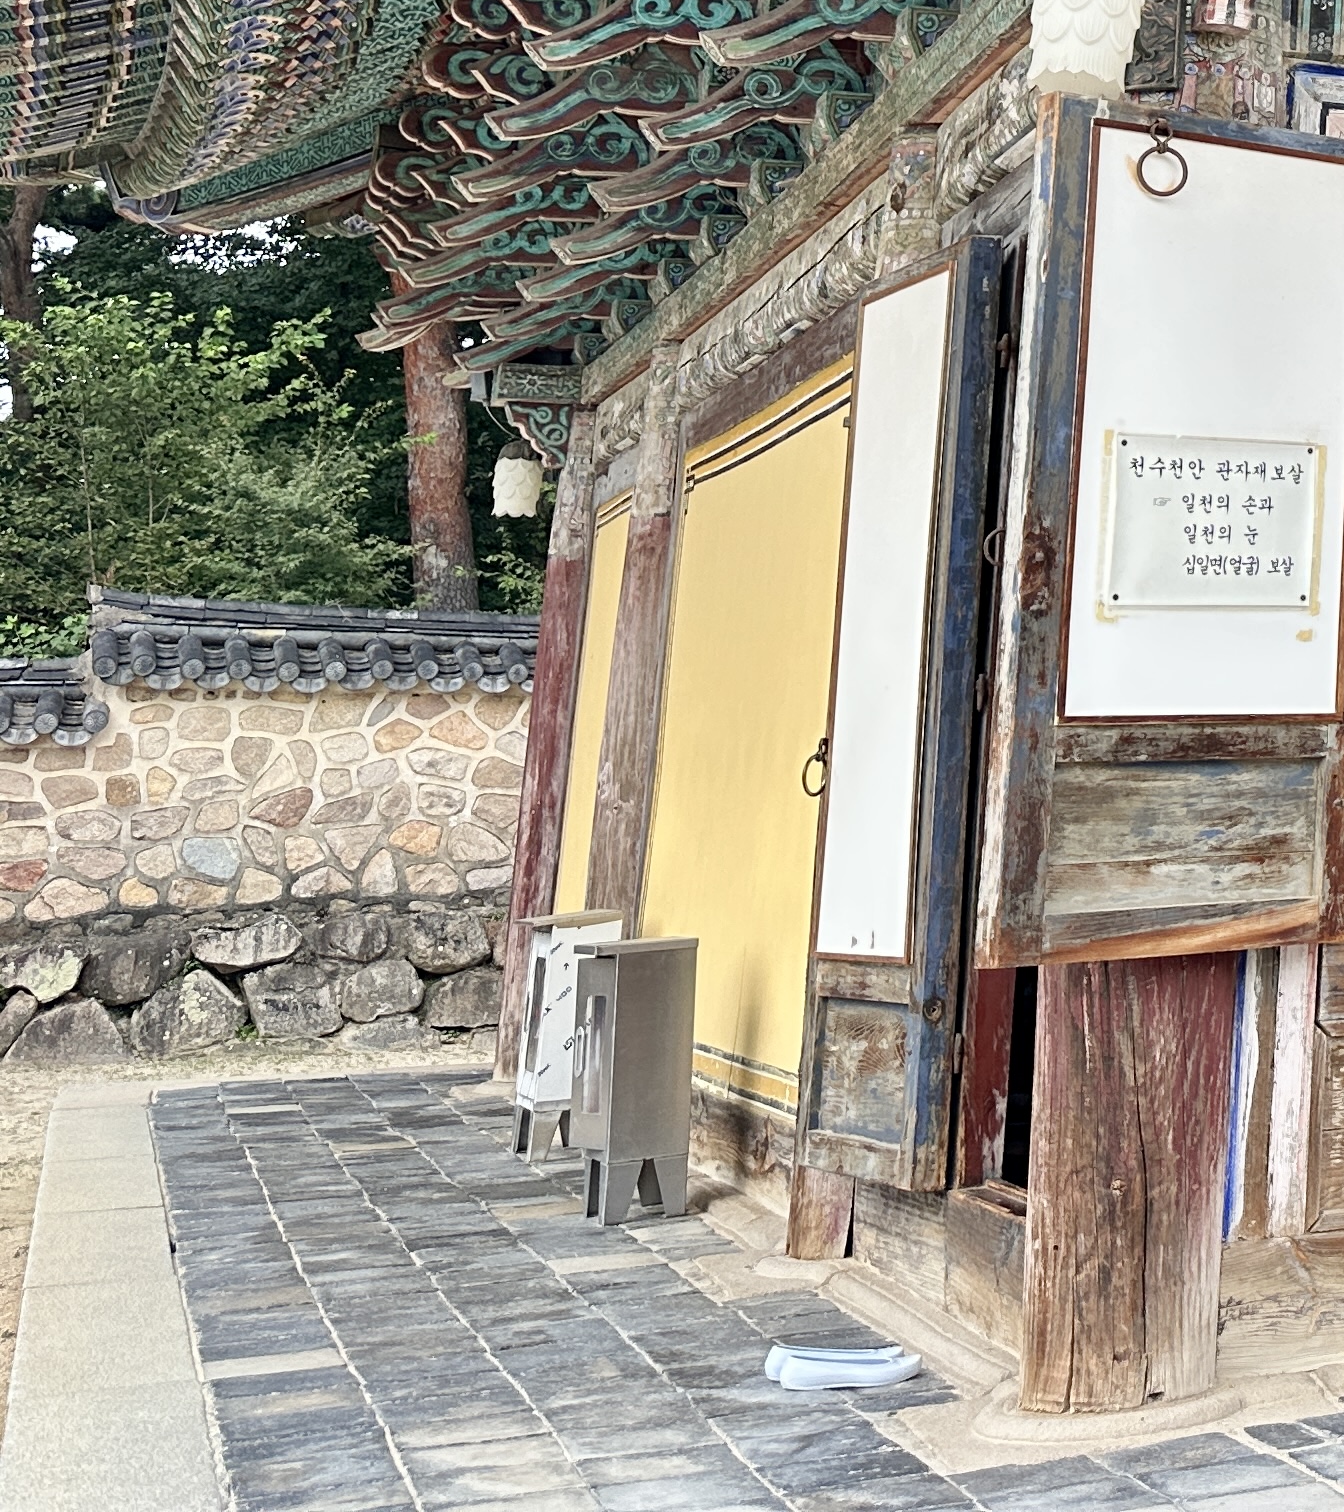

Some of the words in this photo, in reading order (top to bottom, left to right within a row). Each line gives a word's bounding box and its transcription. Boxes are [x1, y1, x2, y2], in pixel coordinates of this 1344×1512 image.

[1129, 456, 1206, 480] 천수천안
[1182, 493, 1230, 515] 일천의
[1242, 495, 1274, 515] 손과
[1184, 523, 1231, 544] 일천의
[1244, 525, 1259, 545] 눈
[1182, 554, 1260, 576] 십일면(얼굴)
[1267, 556, 1294, 576] 보살
